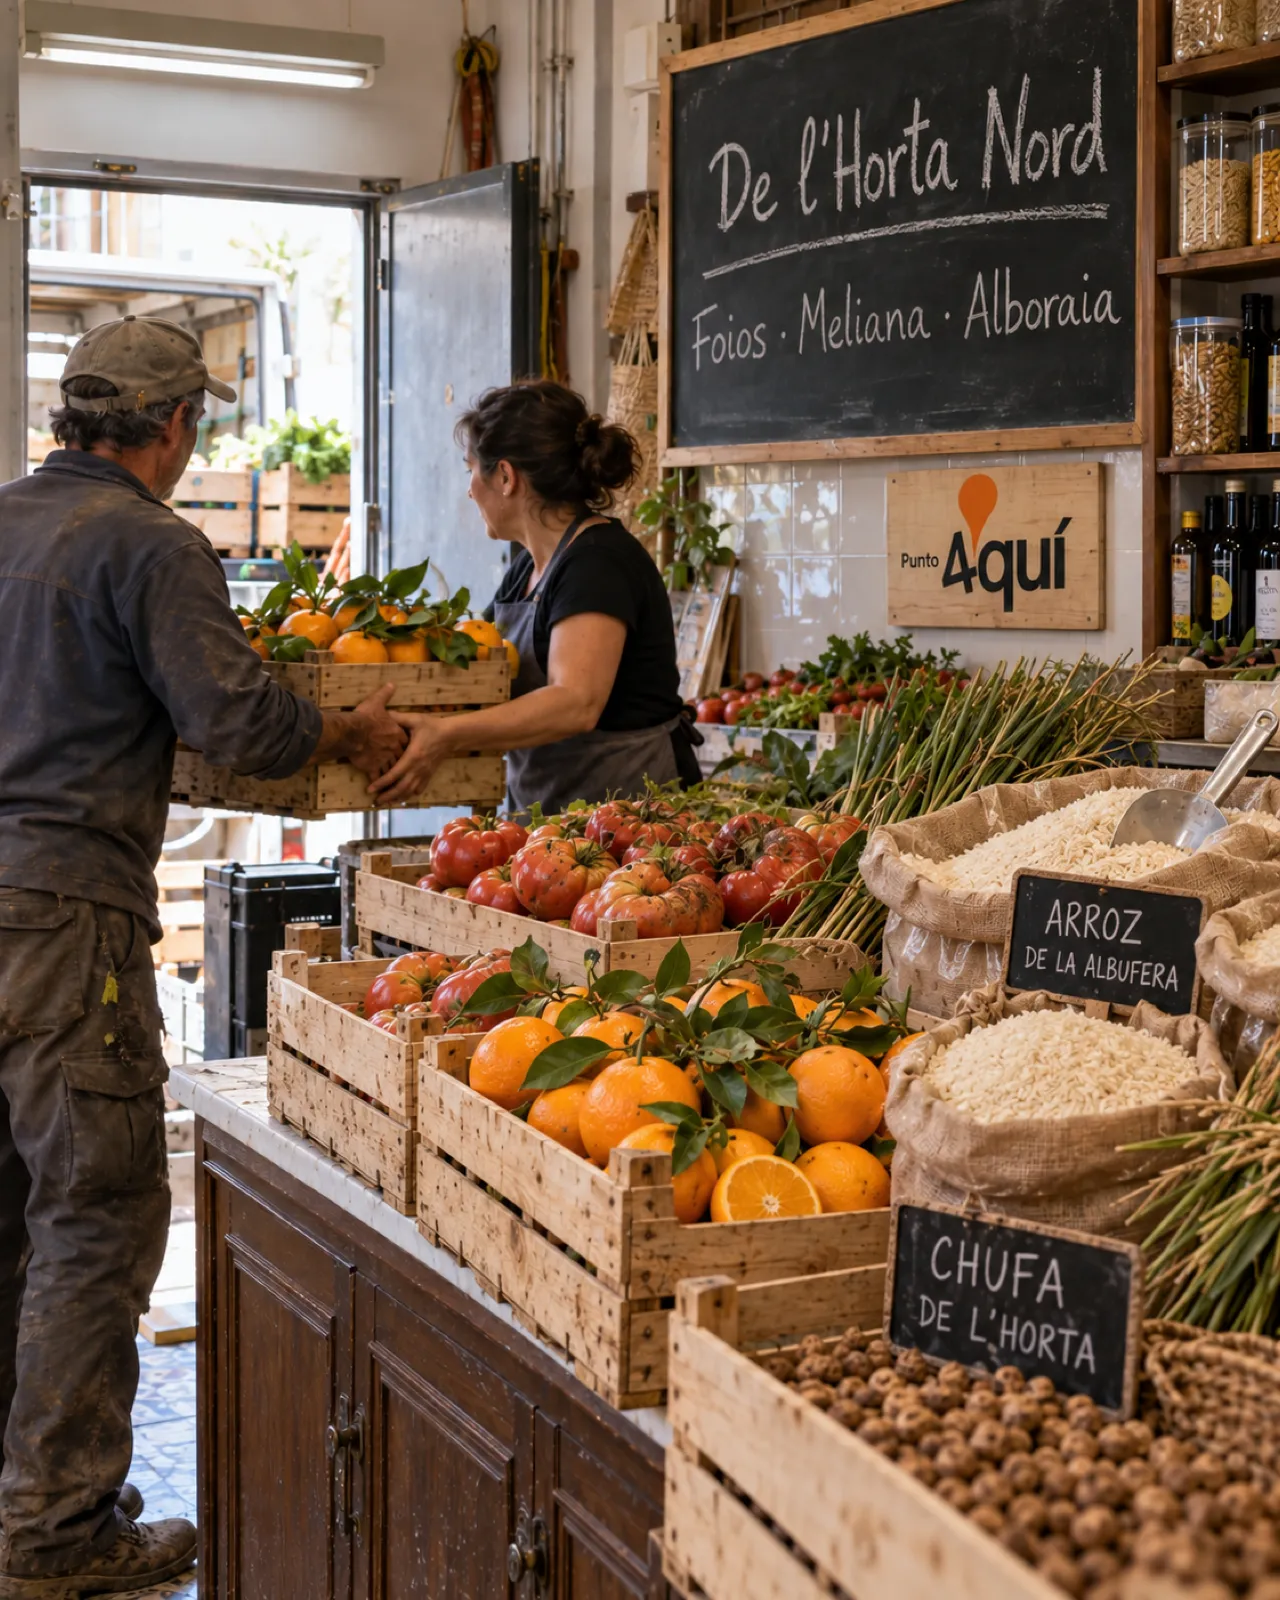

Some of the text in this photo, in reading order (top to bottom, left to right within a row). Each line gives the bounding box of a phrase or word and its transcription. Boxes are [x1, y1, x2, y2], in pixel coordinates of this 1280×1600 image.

[708, 66, 1108, 232] De l'Horta Nord
[692, 266, 1122, 371] Foios Meliana Alboraia
[901, 552, 939, 568] Punto
[1045, 899, 1143, 945] ARROZ
[1024, 945, 1179, 993] DE LA ALBUFERA
[931, 1235, 1064, 1309] CHUFA
[920, 1294, 1096, 1374] DE L'HORTA
